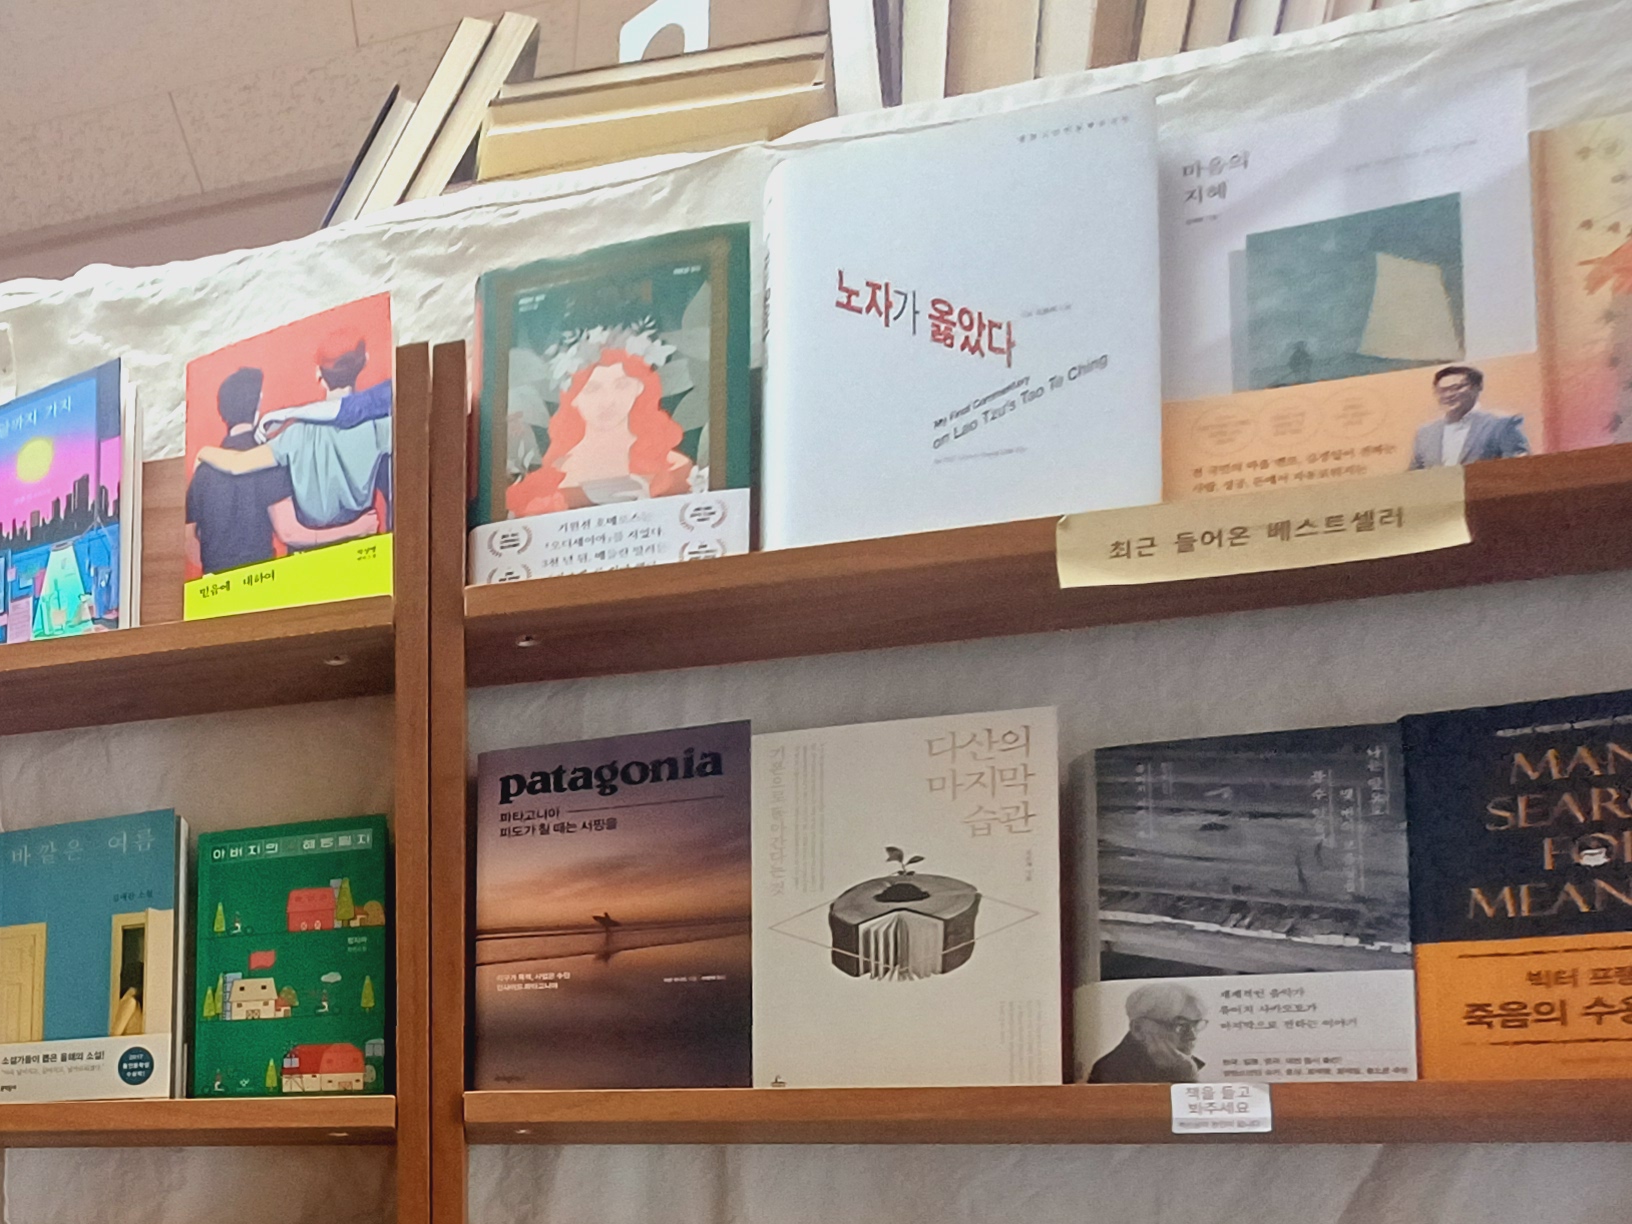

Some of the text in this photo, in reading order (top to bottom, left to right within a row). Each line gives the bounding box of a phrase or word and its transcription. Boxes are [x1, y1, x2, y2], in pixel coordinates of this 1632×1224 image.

[1181, 150, 1251, 180] 마음의
[1182, 180, 1227, 204] 지혜
[834, 268, 1016, 369] 노자가 옳았다
[932, 433, 950, 451] on
[953, 417, 978, 440] Lao
[981, 400, 1017, 425] Tzu's
[1020, 385, 1045, 406] Tao
[1067, 352, 1109, 382] Ching
[1108, 506, 1406, 563] 최근 들어온 베스트셀러
[925, 724, 1032, 764] 다산의
[498, 747, 724, 805] patagonia
[925, 762, 1037, 801] 마지막
[498, 806, 561, 823] 파타고니아
[498, 825, 537, 838] 파도가
[552, 821, 578, 835] 때는
[580, 817, 618, 832] 서핑을
[962, 800, 1038, 838] 습관
[10, 828, 156, 868] 바깥은 여름
[211, 833, 372, 862] 아버지의 해방일지
[1526, 965, 1580, 989] 빅터
[1462, 1000, 1568, 1031] 죽음의
[1220, 1085, 1252, 1100] 들고
[1187, 1101, 1251, 1116] 봐주세요
